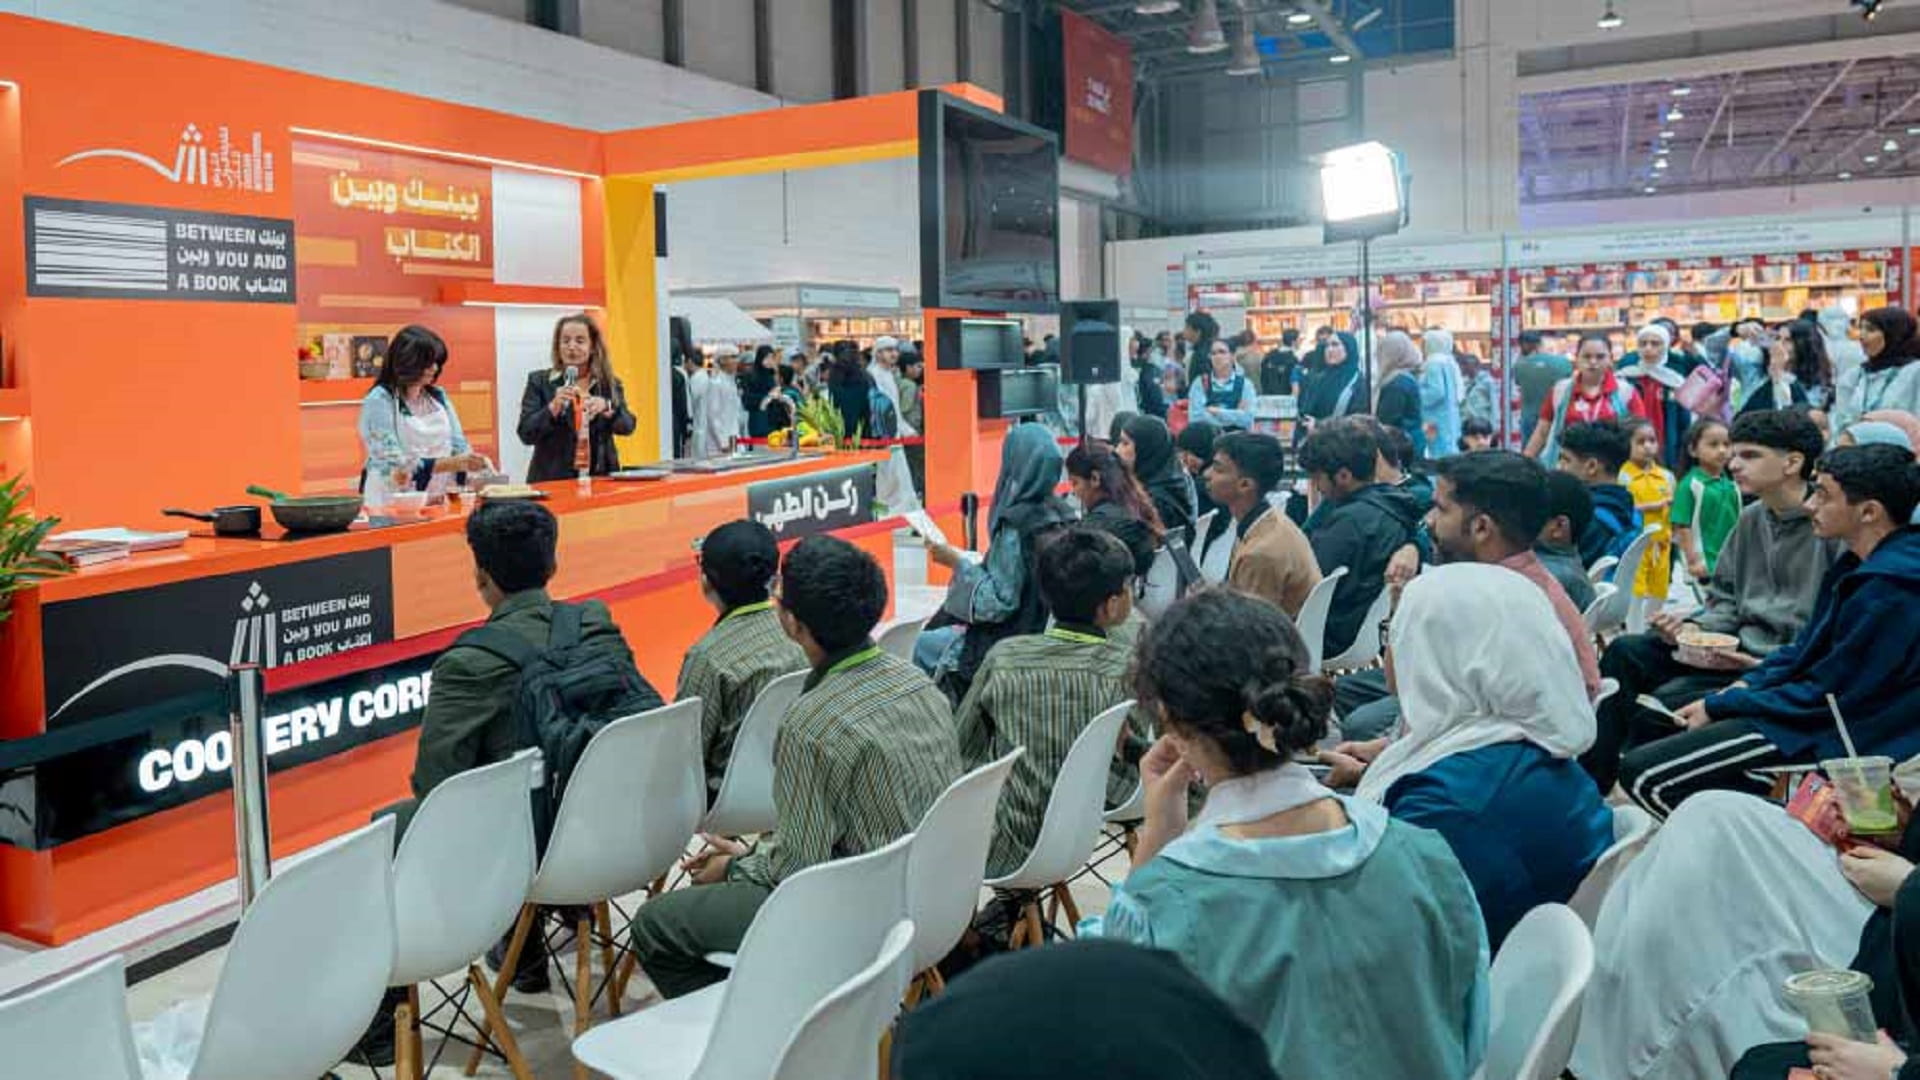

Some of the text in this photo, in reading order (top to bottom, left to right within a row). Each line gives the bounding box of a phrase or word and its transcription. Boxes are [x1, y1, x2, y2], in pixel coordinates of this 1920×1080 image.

[331, 171, 480, 221] بينك وبين
[175, 223, 256, 244] BETWEEN
[177, 246, 210, 267] وبين
[386, 228, 480, 264] الكتاب
[215, 250, 287, 270] YOU AND
[177, 273, 240, 292] A BOOK
[245, 278, 287, 296] الكتاب
[813, 478, 859, 519] ركن
[281, 598, 347, 623] BETWEEN
[314, 613, 372, 637] YOU AND
[283, 642, 334, 667] A BOOK
[138, 671, 433, 793] COOERY COR
